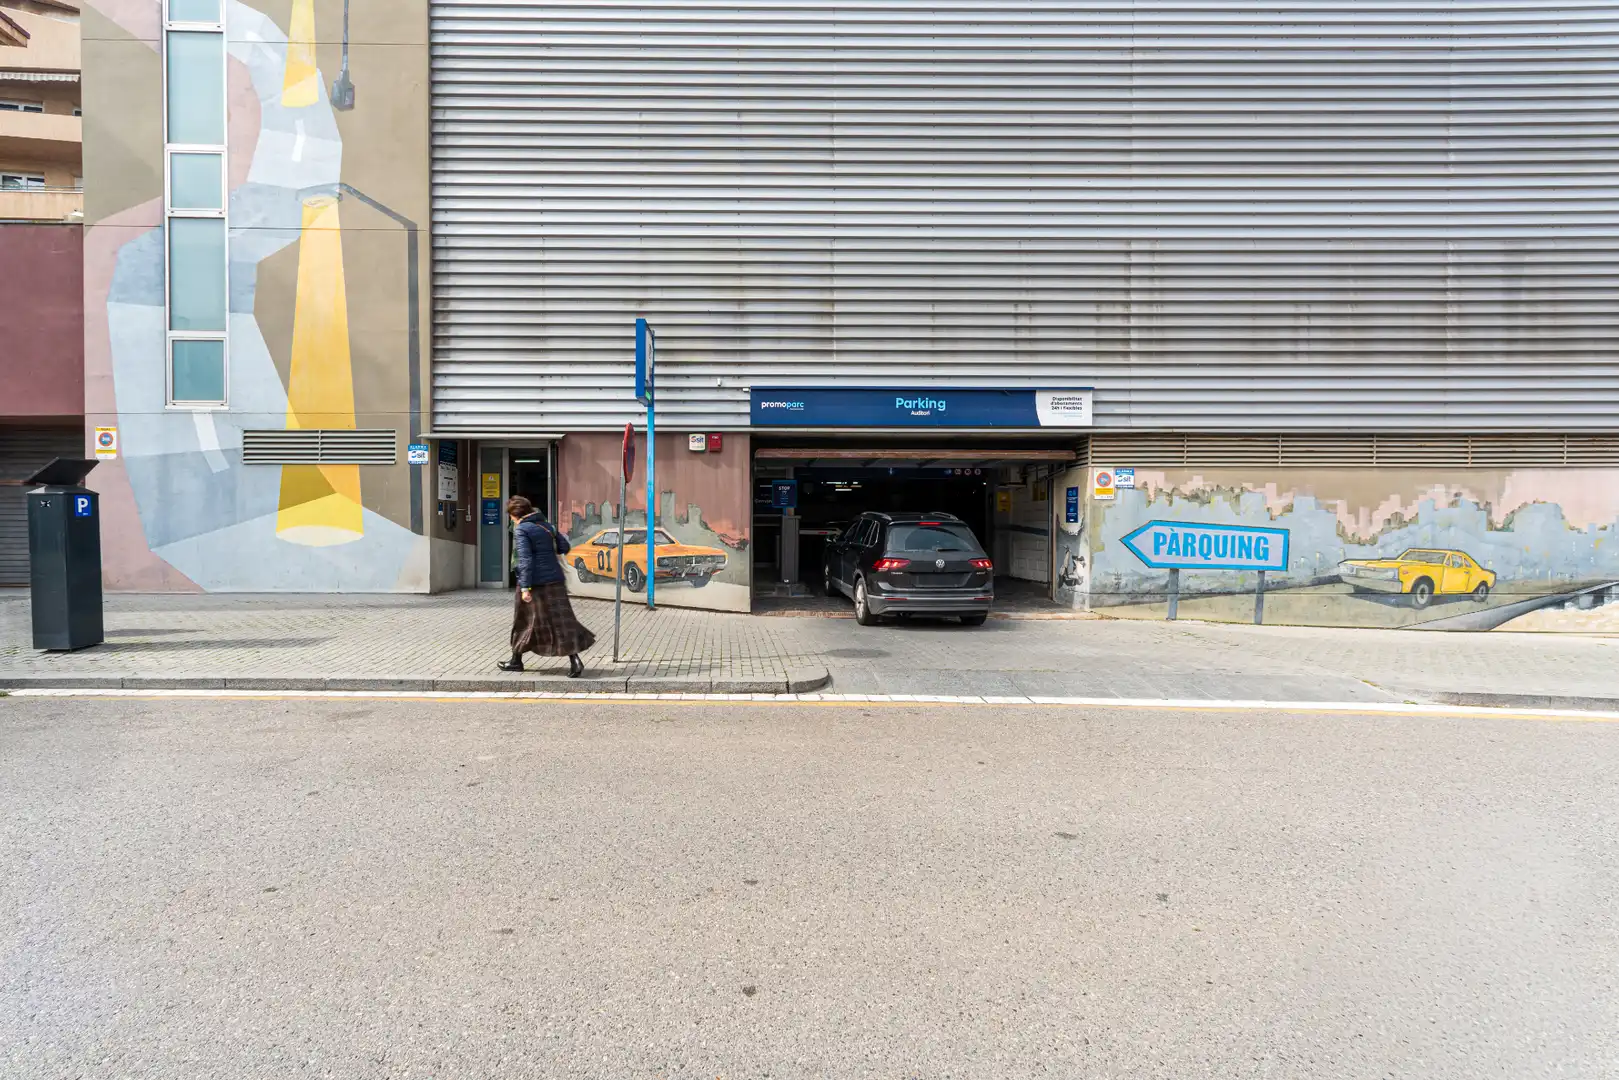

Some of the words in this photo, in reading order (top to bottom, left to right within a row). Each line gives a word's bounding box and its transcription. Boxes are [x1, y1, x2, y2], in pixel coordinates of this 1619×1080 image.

[761, 401, 804, 409] promoparc
[895, 397, 946, 411] Parking
[78, 498, 88, 513] P
[1153, 528, 1270, 561] PÀRQUING
[597, 550, 612, 572] 01
